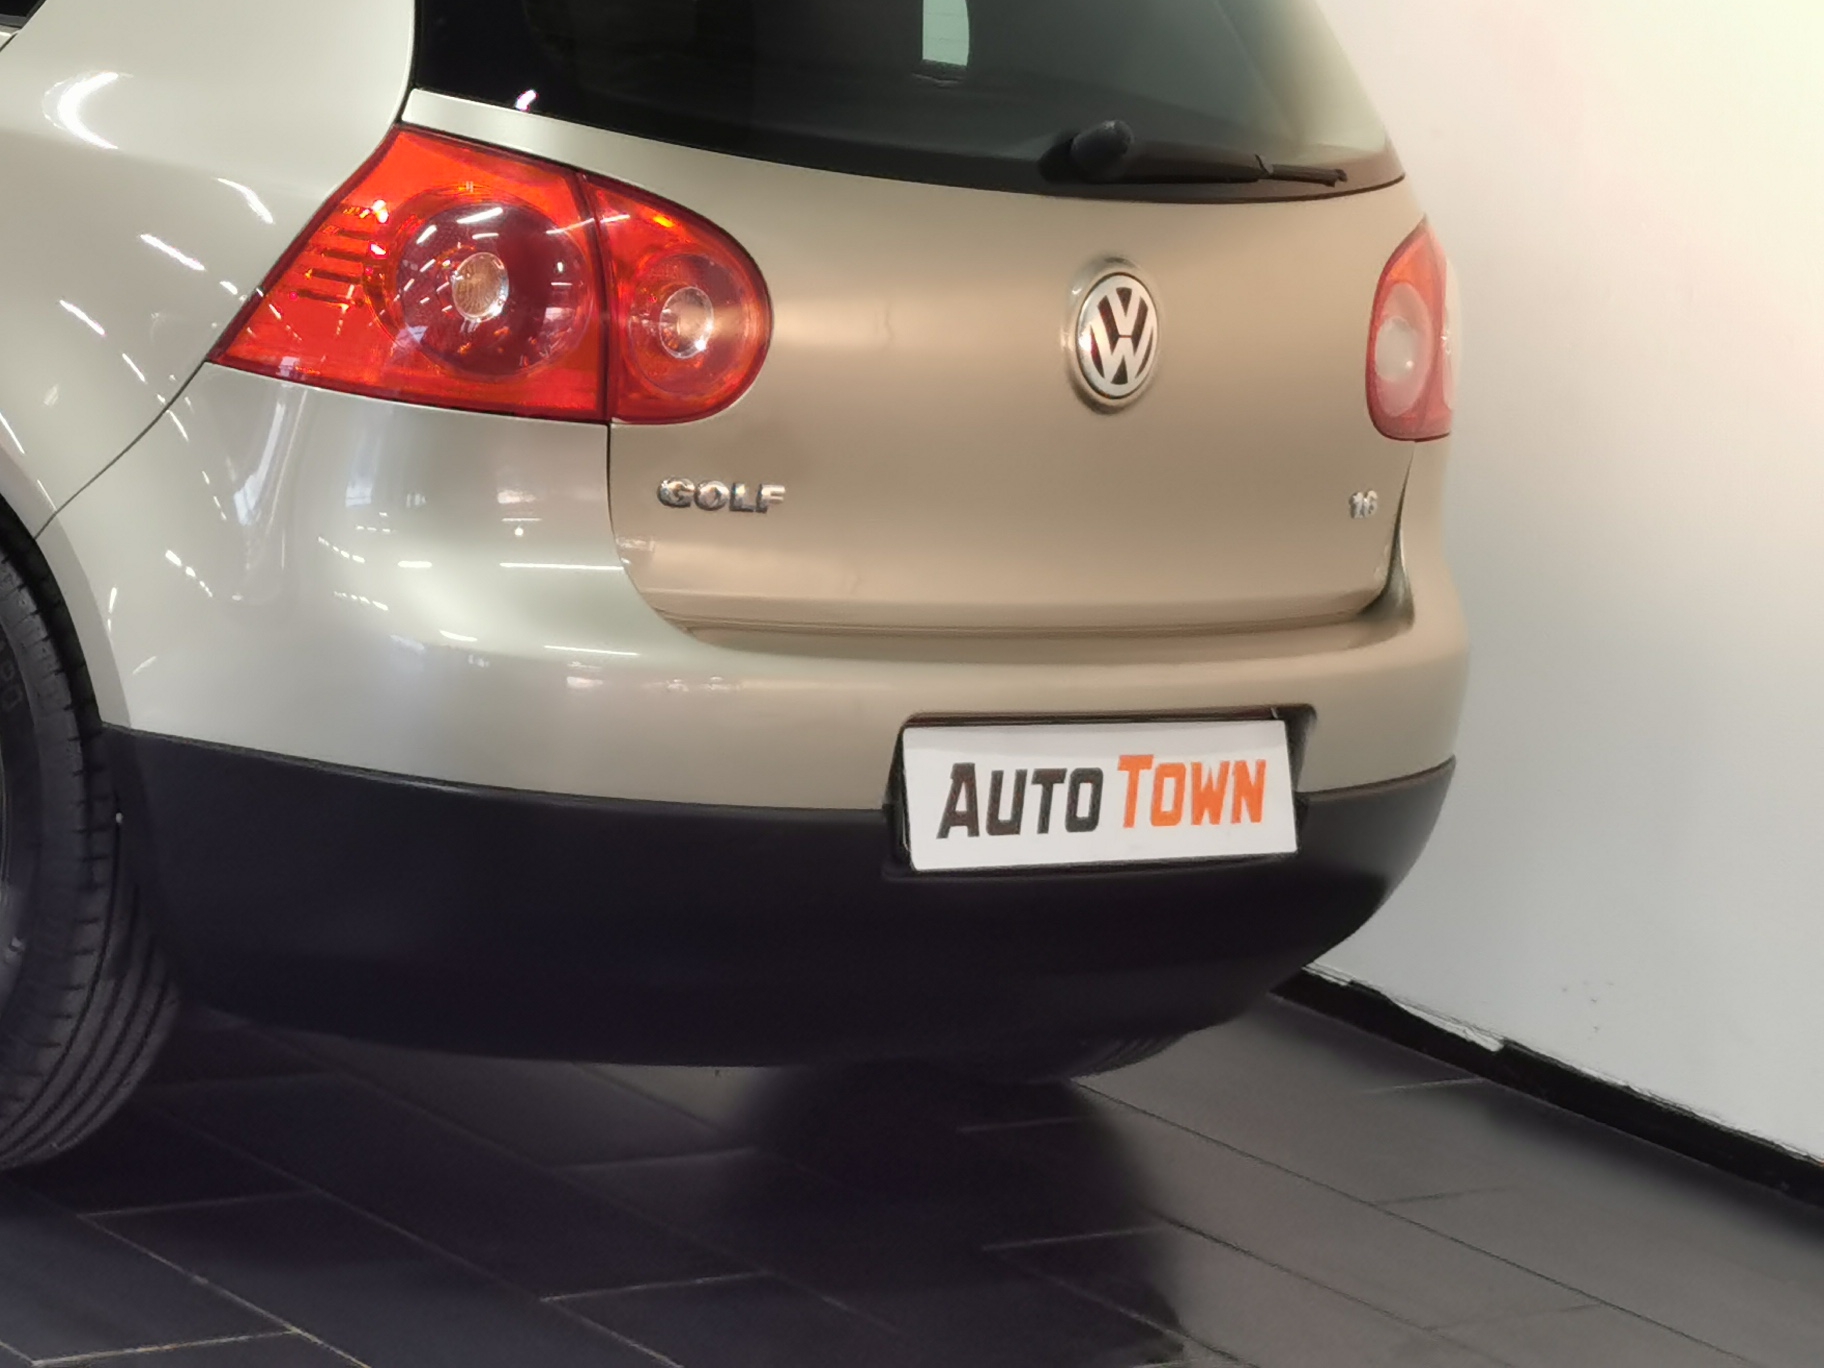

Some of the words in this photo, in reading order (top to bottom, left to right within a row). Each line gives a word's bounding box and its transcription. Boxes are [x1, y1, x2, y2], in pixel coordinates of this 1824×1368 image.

[656, 476, 786, 514] GOLF
[936, 762, 1104, 839] AUTO
[1118, 754, 1267, 828] TOWN
